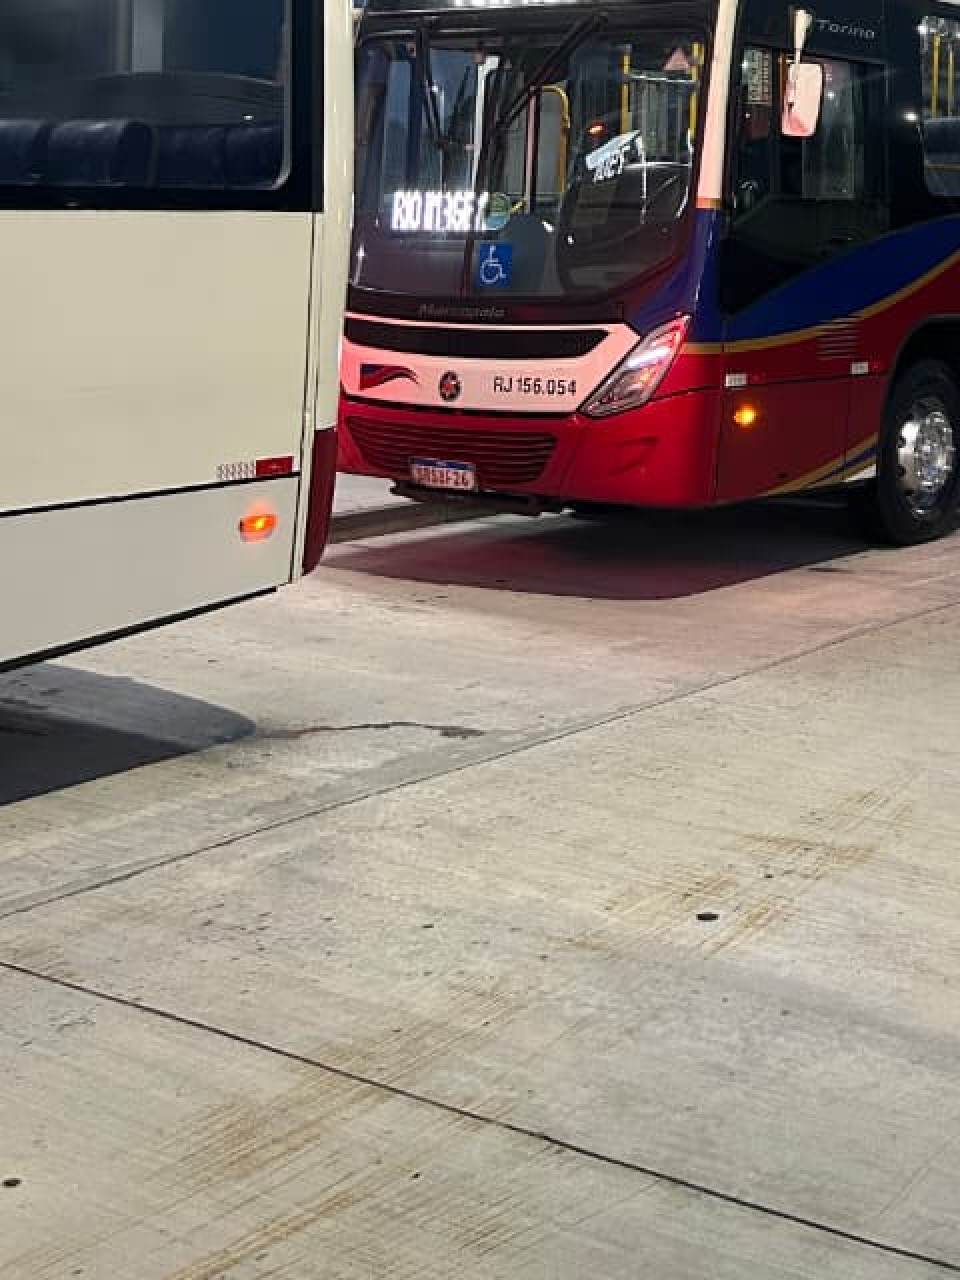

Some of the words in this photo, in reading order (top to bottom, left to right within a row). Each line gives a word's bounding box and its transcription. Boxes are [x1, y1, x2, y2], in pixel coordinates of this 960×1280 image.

[815, 19, 875, 39] Torino
[493, 375, 513, 393] RJ
[515, 376, 577, 396] 156.054
